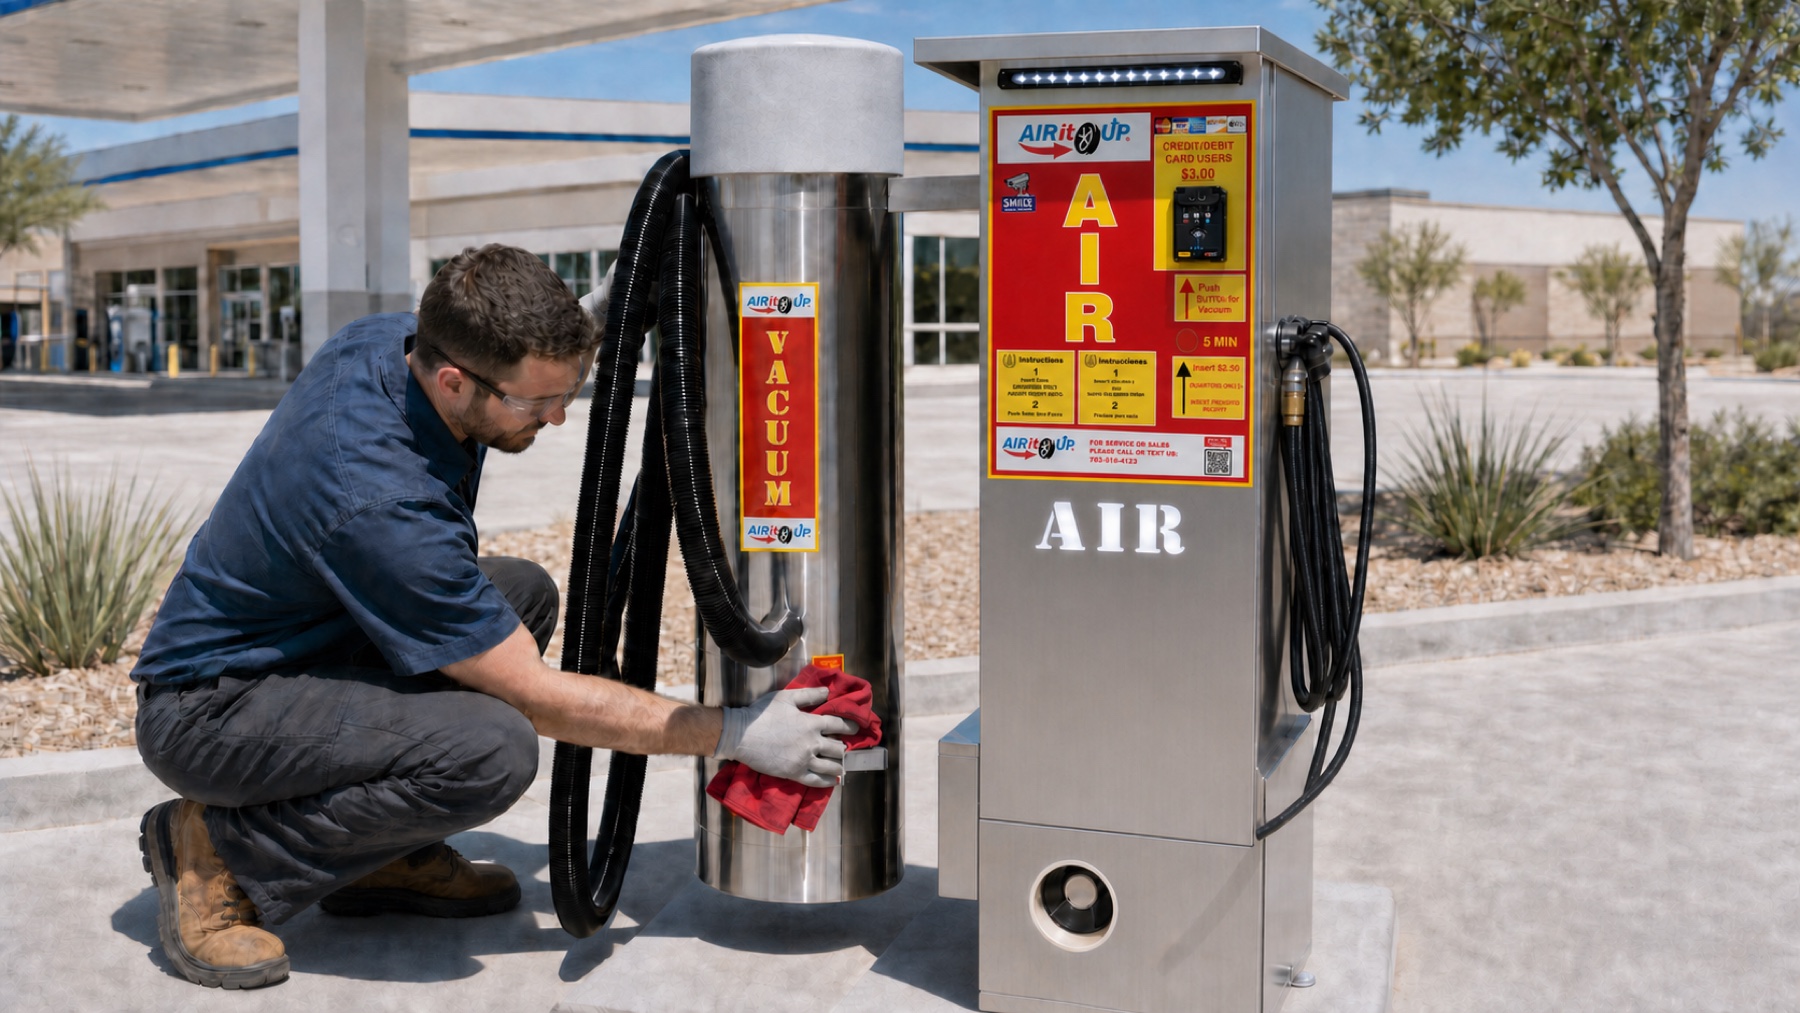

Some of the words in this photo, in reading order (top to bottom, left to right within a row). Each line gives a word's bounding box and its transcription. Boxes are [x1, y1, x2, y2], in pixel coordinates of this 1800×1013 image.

[1163, 141, 1234, 151] CREDIT/DEBIT
[1165, 154, 1195, 164] CARD
[1197, 154, 1233, 163] USERS
[1181, 168, 1215, 181] $3.00
[1062, 173, 1118, 343] AIR
[1198, 283, 1221, 292] Push
[1227, 294, 1240, 304] for
[1203, 336, 1211, 348] 5
[1213, 336, 1238, 348] MIN
[1018, 356, 1064, 364] Instructions
[1033, 367, 1039, 376] 1
[1113, 368, 1119, 378] 1
[1192, 364, 1215, 372] Insert
[1031, 400, 1039, 409] 2
[1111, 401, 1119, 410] 2
[764, 330, 792, 506] VACUUM
[1035, 501, 1185, 555] AIR
